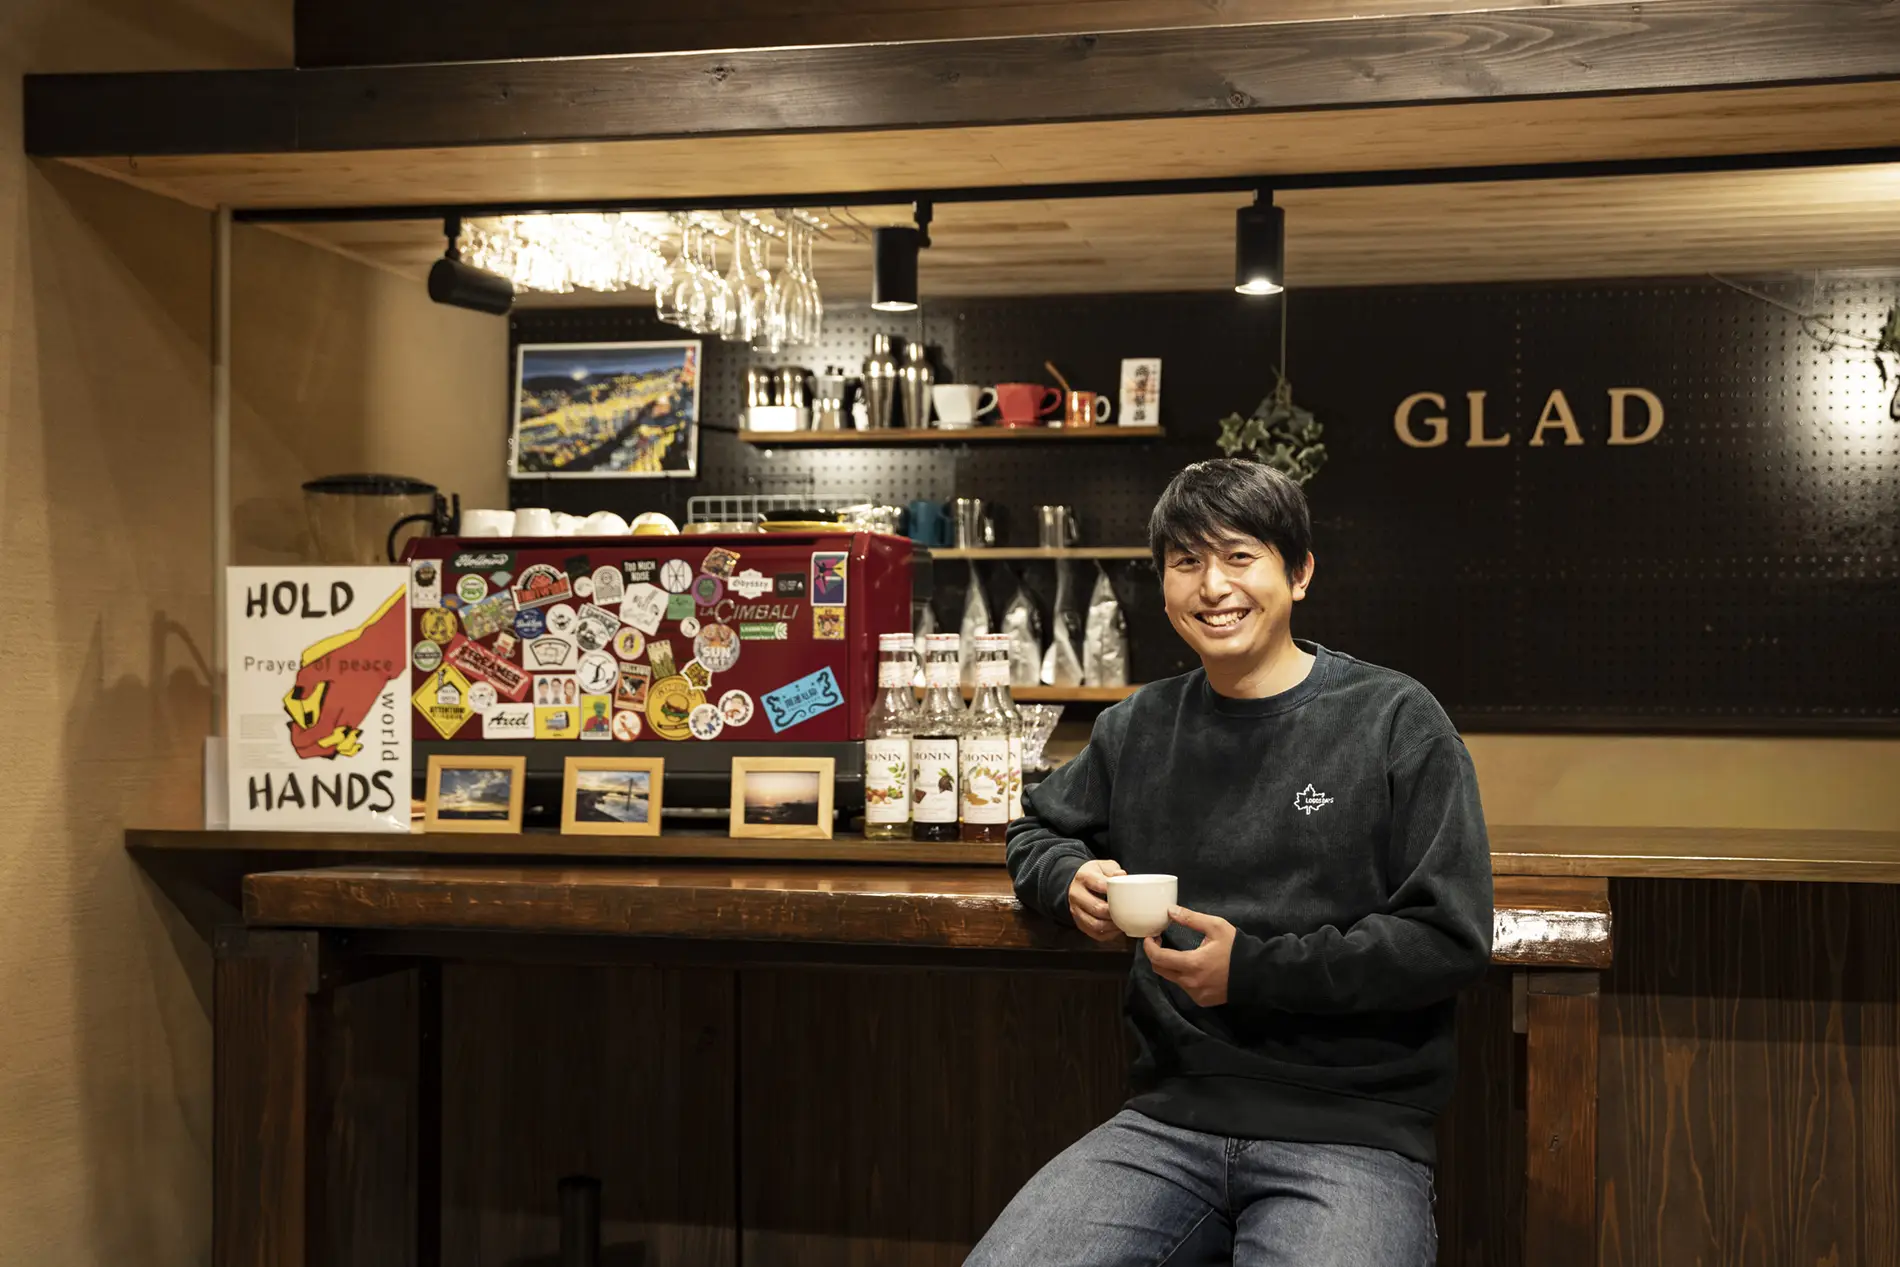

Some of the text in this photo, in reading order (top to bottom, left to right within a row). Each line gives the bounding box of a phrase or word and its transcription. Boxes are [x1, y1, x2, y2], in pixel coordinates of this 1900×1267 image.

[1394, 387, 1664, 448] GLAD
[245, 580, 355, 619] HOLD
[700, 599, 800, 623] LA CIMBALI
[313, 655, 332, 671] of
[339, 659, 393, 677] peace
[458, 645, 521, 683] STREAMER
[703, 647, 731, 659] SUN
[381, 692, 400, 762] world
[248, 769, 396, 813] HANDS
